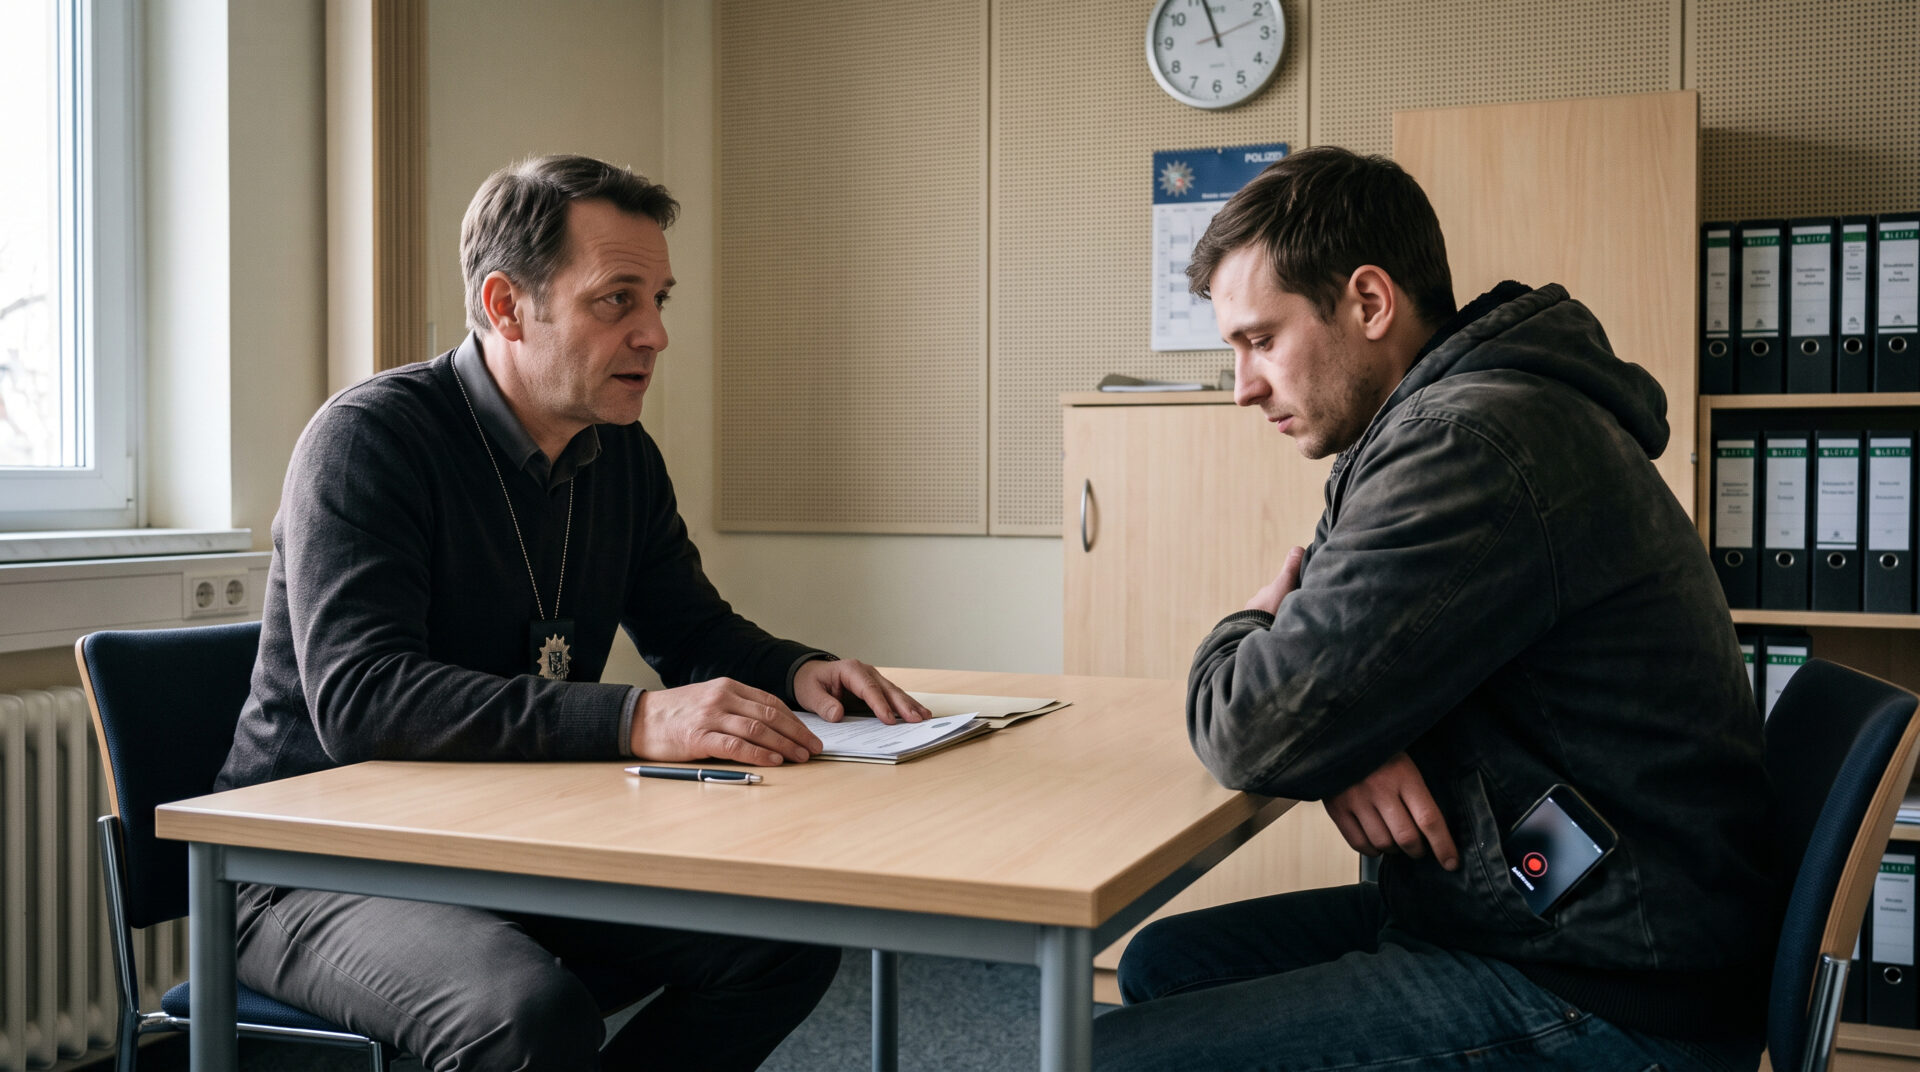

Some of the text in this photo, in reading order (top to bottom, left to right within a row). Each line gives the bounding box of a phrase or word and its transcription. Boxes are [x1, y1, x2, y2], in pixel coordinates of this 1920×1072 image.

[1252, 2, 1263, 17] 2
[1171, 12, 1186, 27] 10
[1260, 26, 1270, 40] 3
[1164, 37, 1174, 50] 9
[1253, 51, 1263, 64] 4
[1171, 60, 1181, 74] 8
[1189, 76, 1198, 90] 7
[1236, 70, 1246, 84] 5
[1212, 80, 1222, 93] 6
[1244, 151, 1283, 163] POLIZEI
